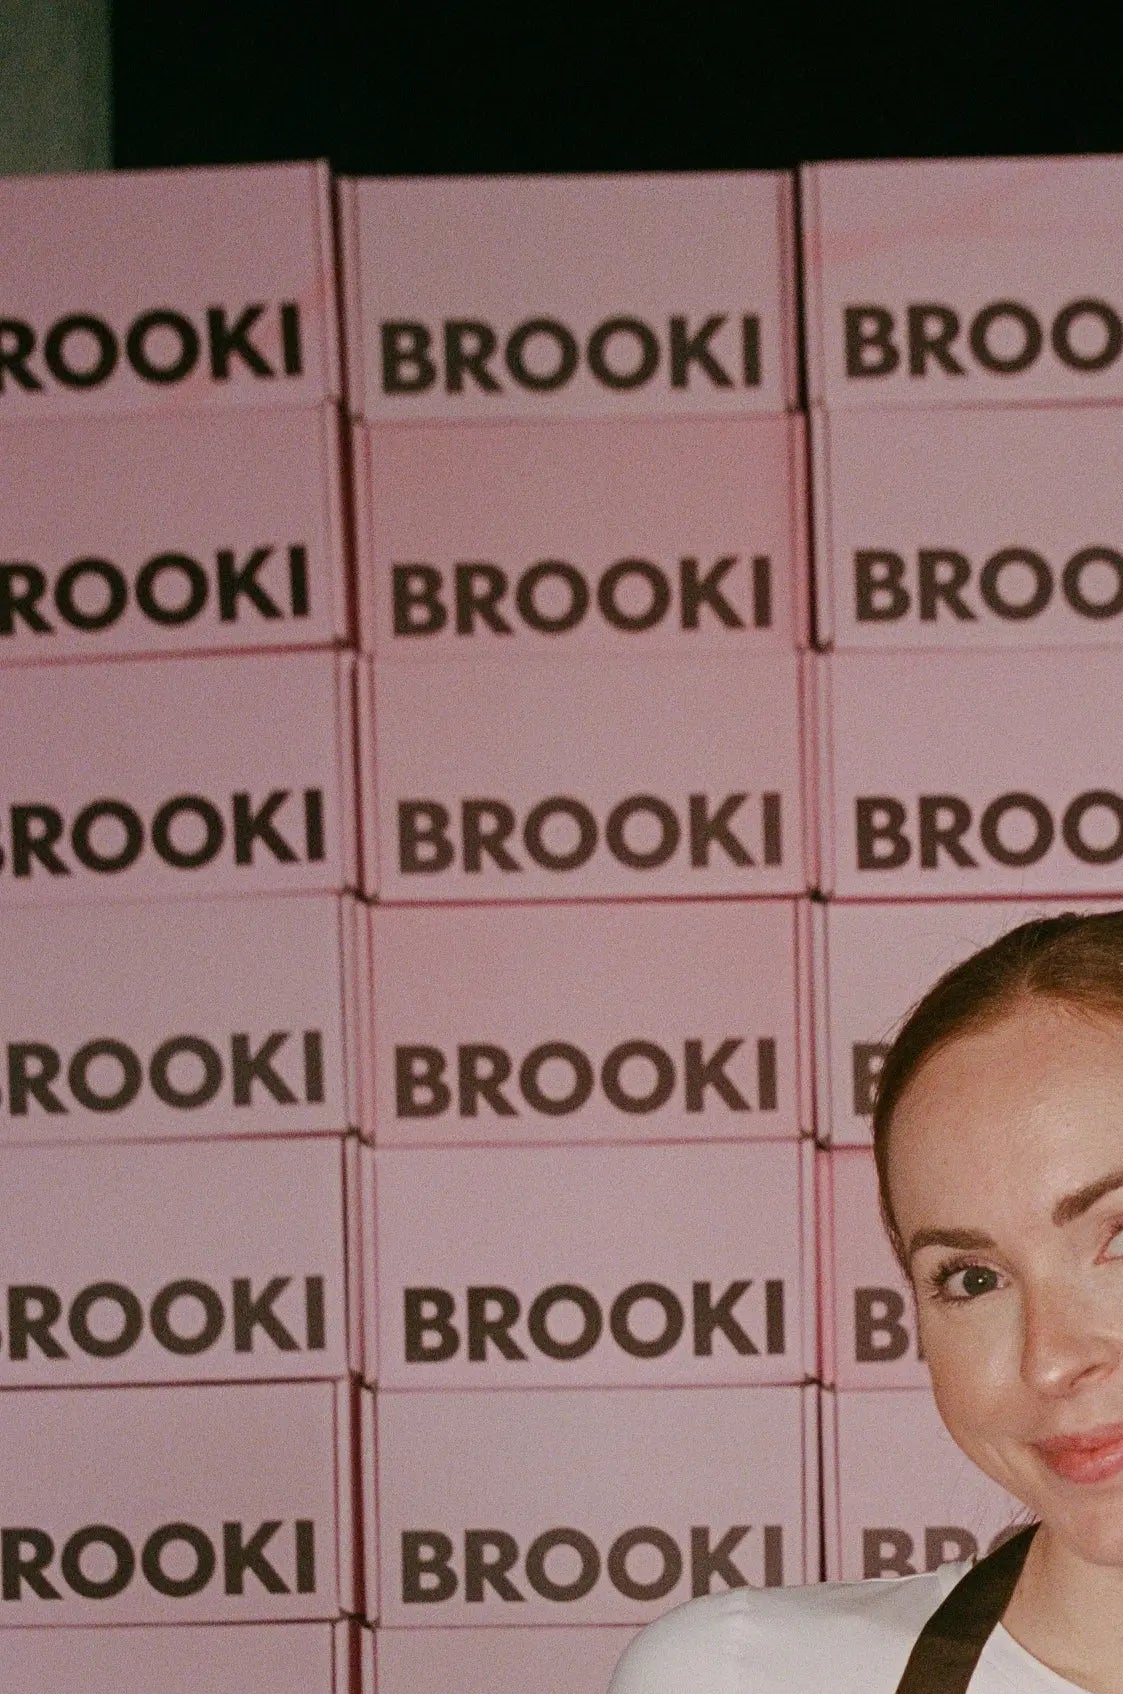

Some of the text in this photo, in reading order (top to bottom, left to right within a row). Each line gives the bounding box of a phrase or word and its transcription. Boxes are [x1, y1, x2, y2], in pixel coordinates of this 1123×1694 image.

[0, 303, 302, 392] ROOKI
[380, 315, 760, 395] BROOKI
[0, 545, 309, 636] ROOKI
[392, 556, 771, 637] BROOKI
[0, 789, 324, 877] ROOKI
[398, 793, 782, 874] BROOKI
[0, 1031, 323, 1116] ROOKI
[395, 1038, 776, 1118] BROOKI
[0, 1277, 325, 1360] ROOKI
[404, 1280, 784, 1363] BROOKI
[0, 1520, 315, 1600] ROOKI
[401, 1527, 782, 1604] BROOKI
